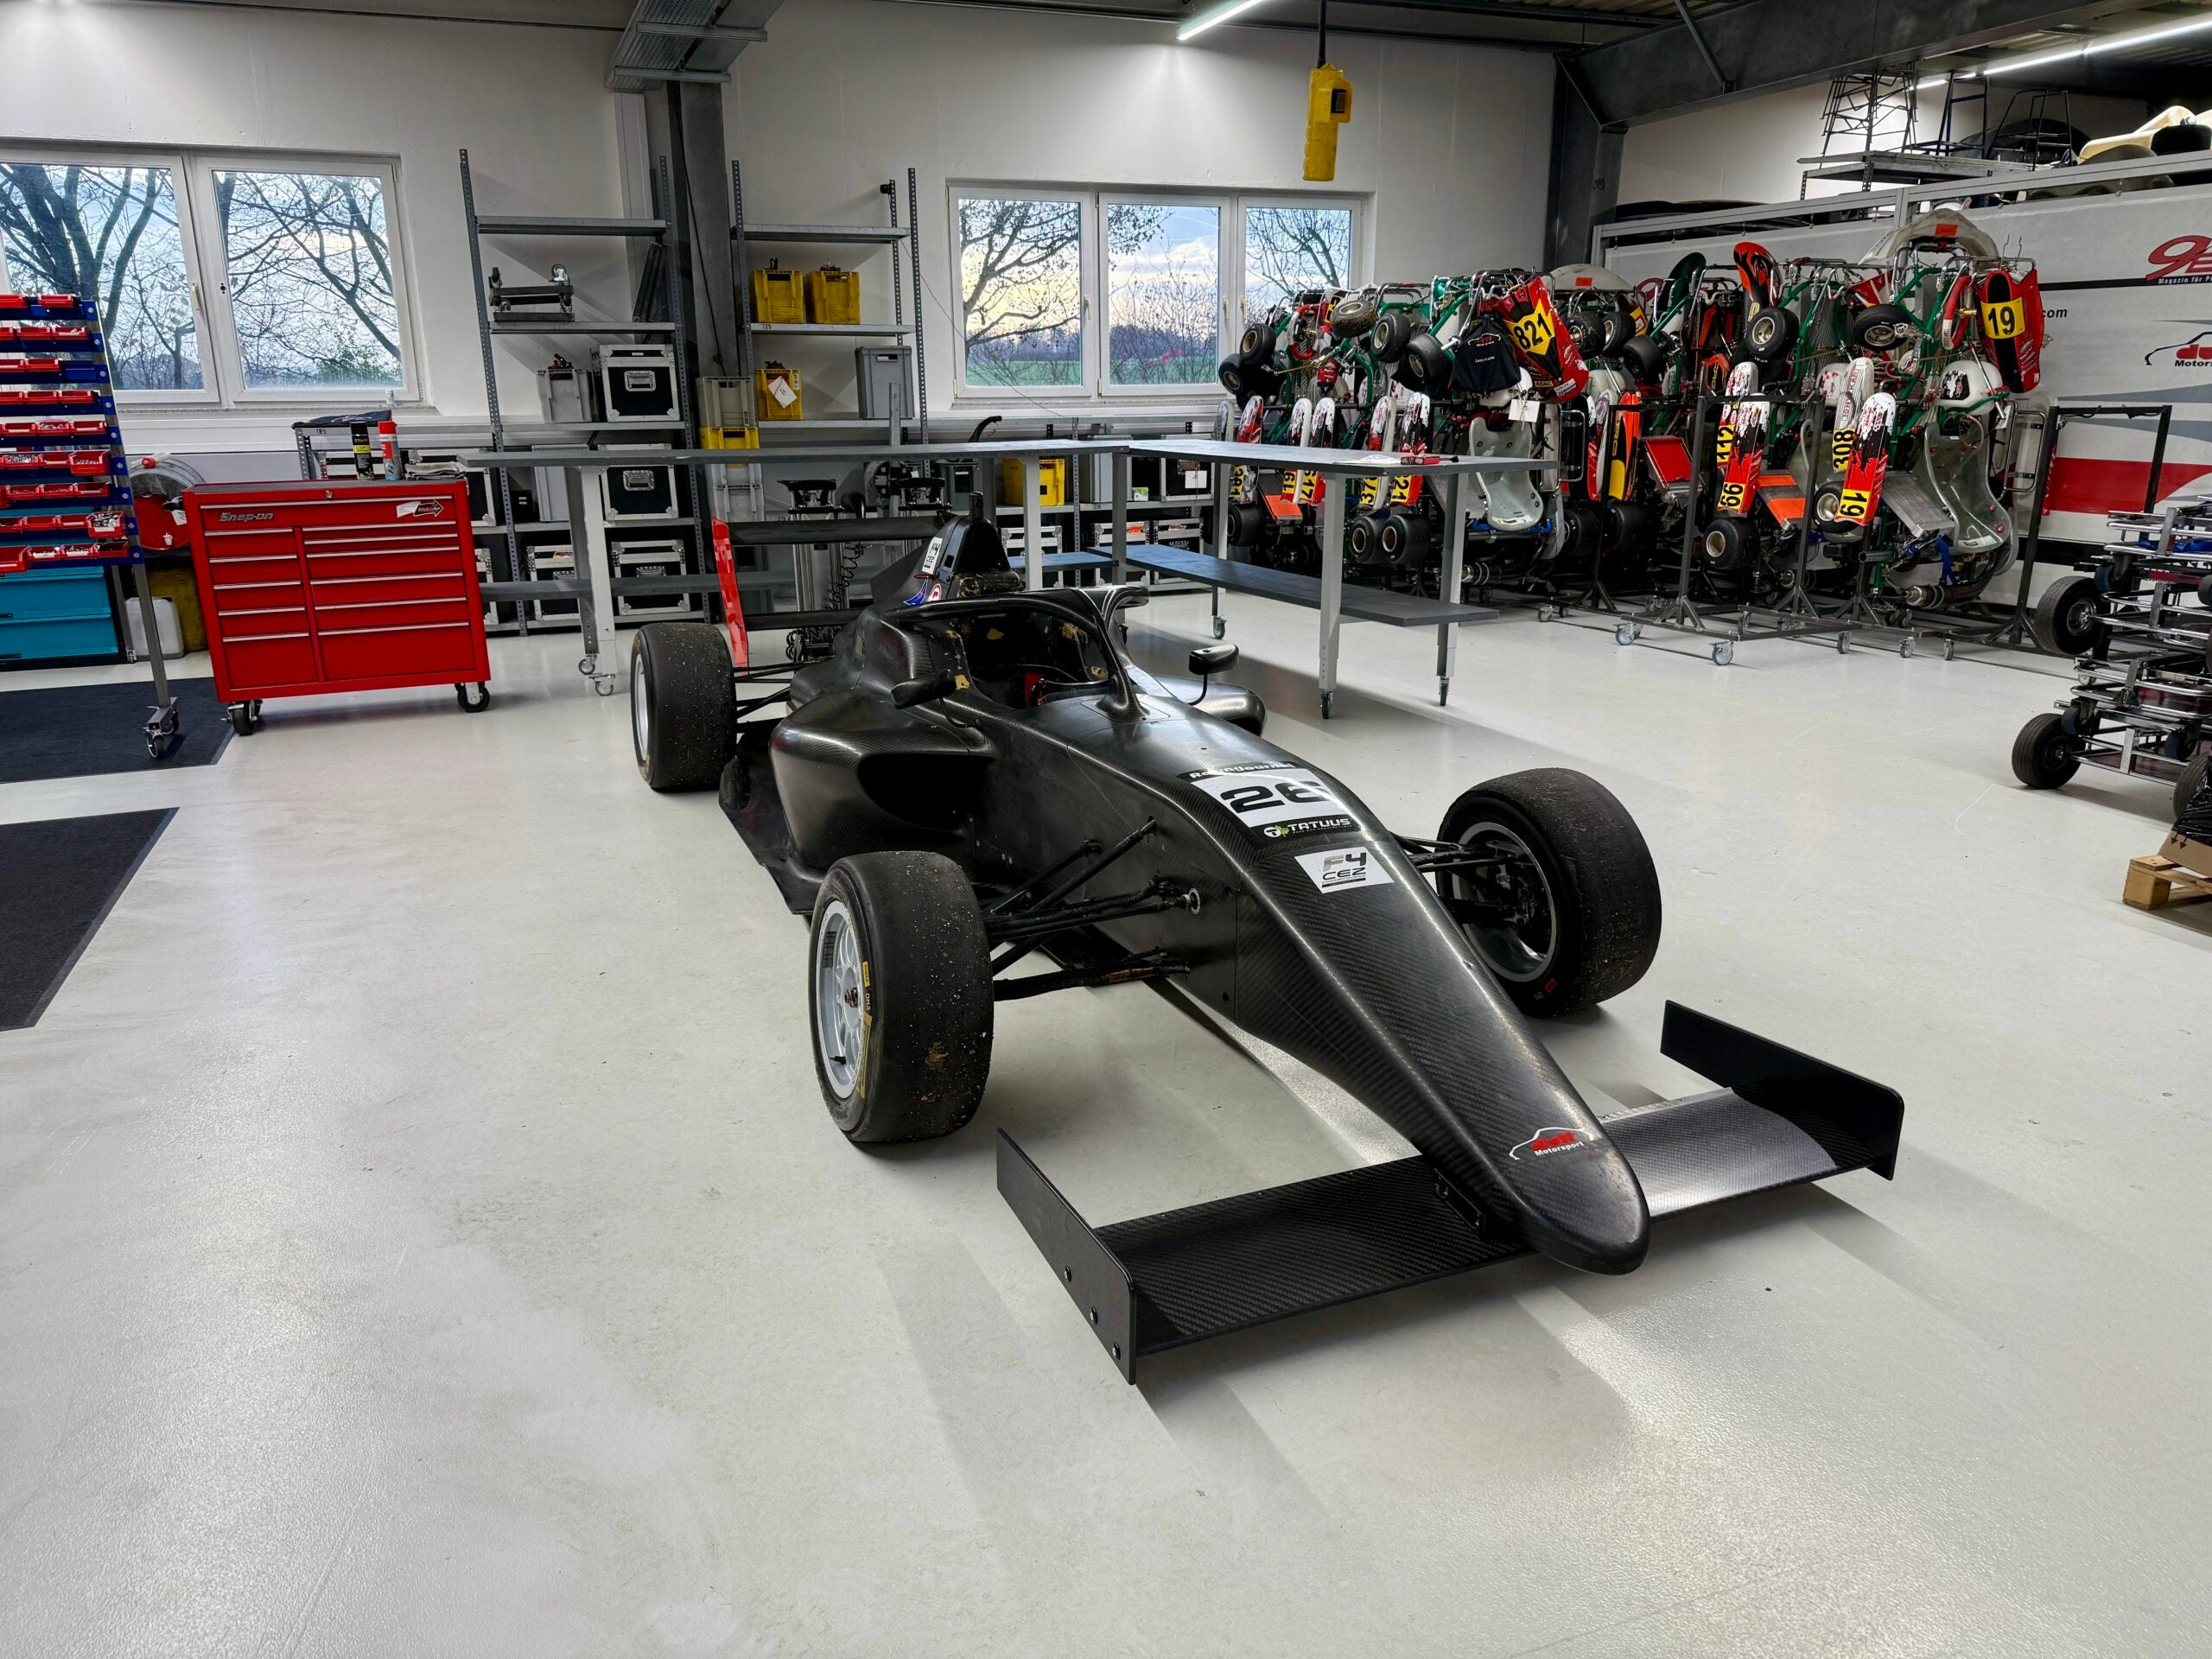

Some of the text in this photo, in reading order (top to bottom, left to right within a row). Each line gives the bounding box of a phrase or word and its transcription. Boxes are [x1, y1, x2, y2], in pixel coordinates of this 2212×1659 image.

[1513, 312, 1553, 350] 821
[1988, 306, 2016, 335] 19
[1833, 429, 1854, 470] 308
[1840, 492, 1868, 517] 19
[219, 512, 274, 523] Snap-on
[1220, 780, 1332, 814] 26
[1322, 867, 1367, 880] CEZ
[1323, 852, 1367, 873] F4
[1534, 1141, 1585, 1157] Motorsport
